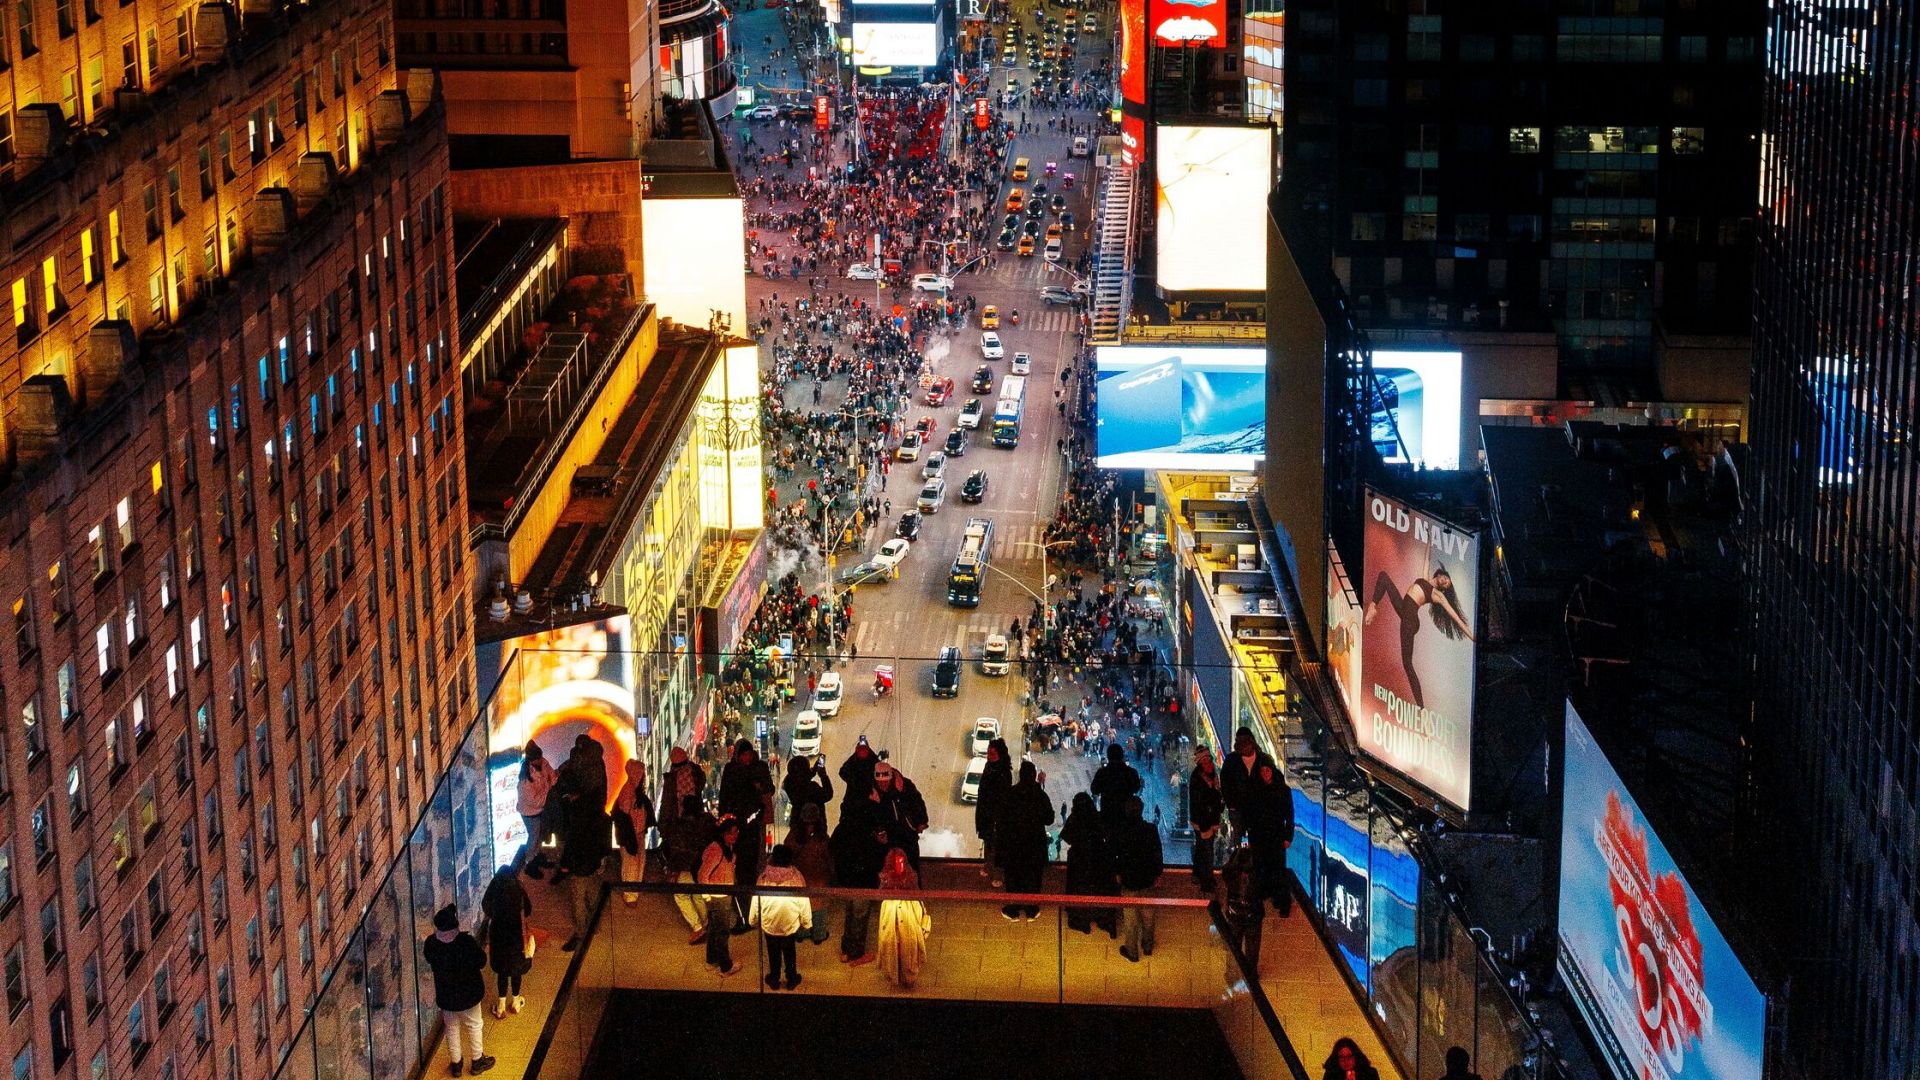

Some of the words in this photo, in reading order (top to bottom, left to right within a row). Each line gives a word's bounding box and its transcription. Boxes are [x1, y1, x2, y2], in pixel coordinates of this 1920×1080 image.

[1371, 498, 1410, 533] OLD
[1414, 516, 1469, 561] NAVY
[1373, 712, 1457, 786] BOUNDLESS
[1374, 682, 1388, 703] NEW
[1387, 690, 1456, 749] POWERSOFT
[1611, 852, 1629, 890] YOUR
[1660, 932, 1695, 997] SENDING
[1615, 904, 1684, 1073] SOS
